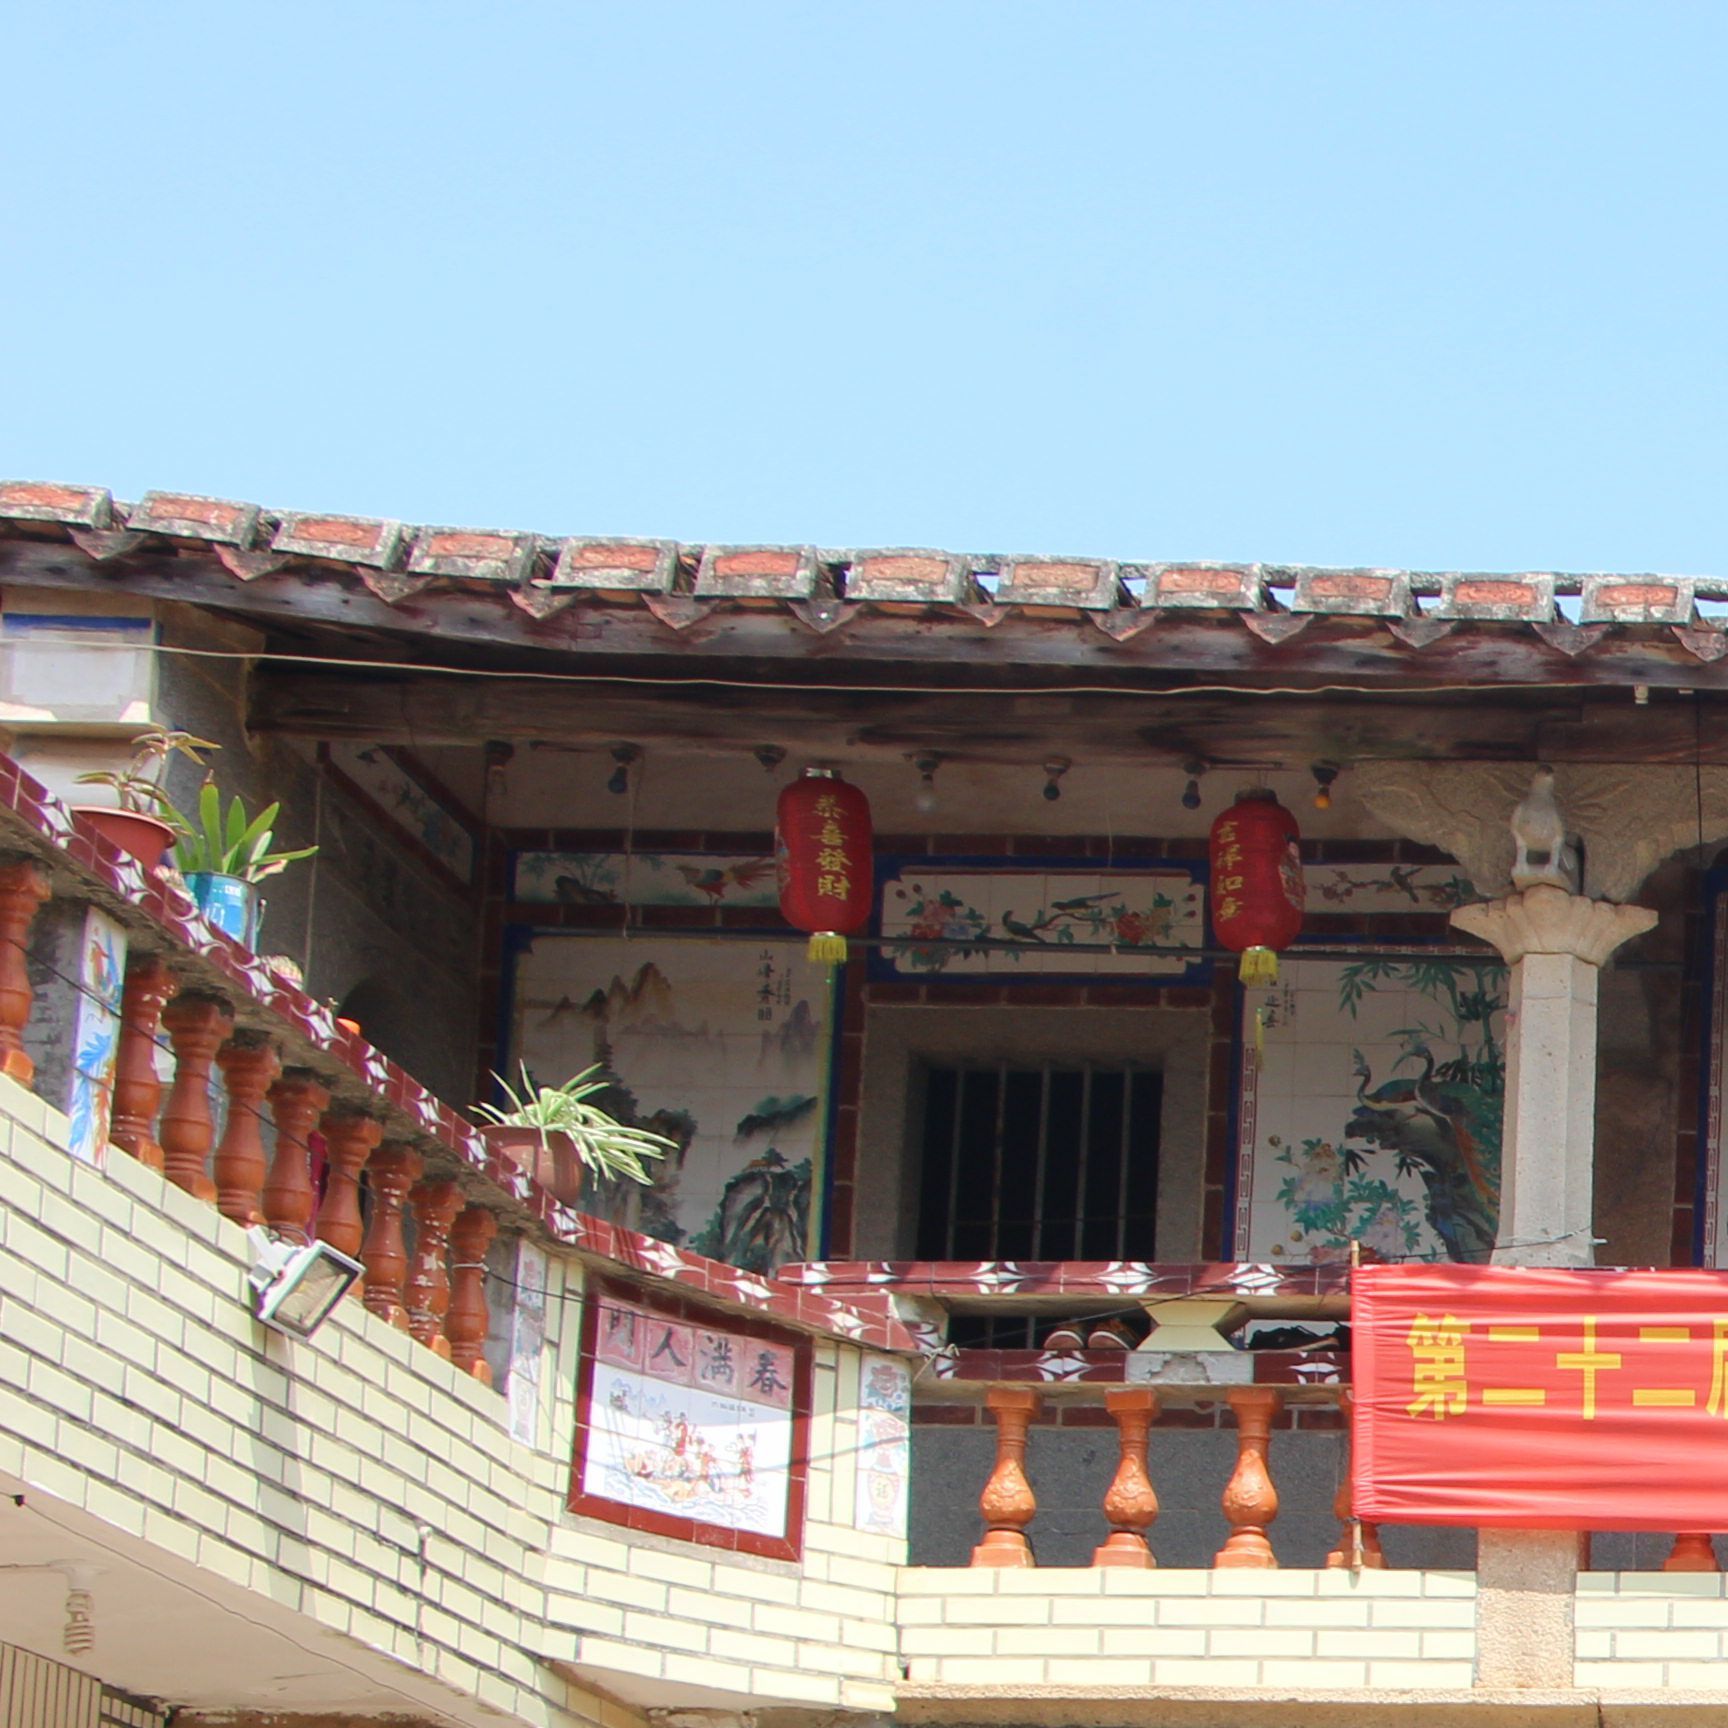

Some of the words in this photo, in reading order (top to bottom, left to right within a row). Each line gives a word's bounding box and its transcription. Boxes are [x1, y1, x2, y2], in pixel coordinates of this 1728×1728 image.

[809, 794, 853, 901] 恭喜發財
[1215, 820, 1245, 922] 吉祥如意
